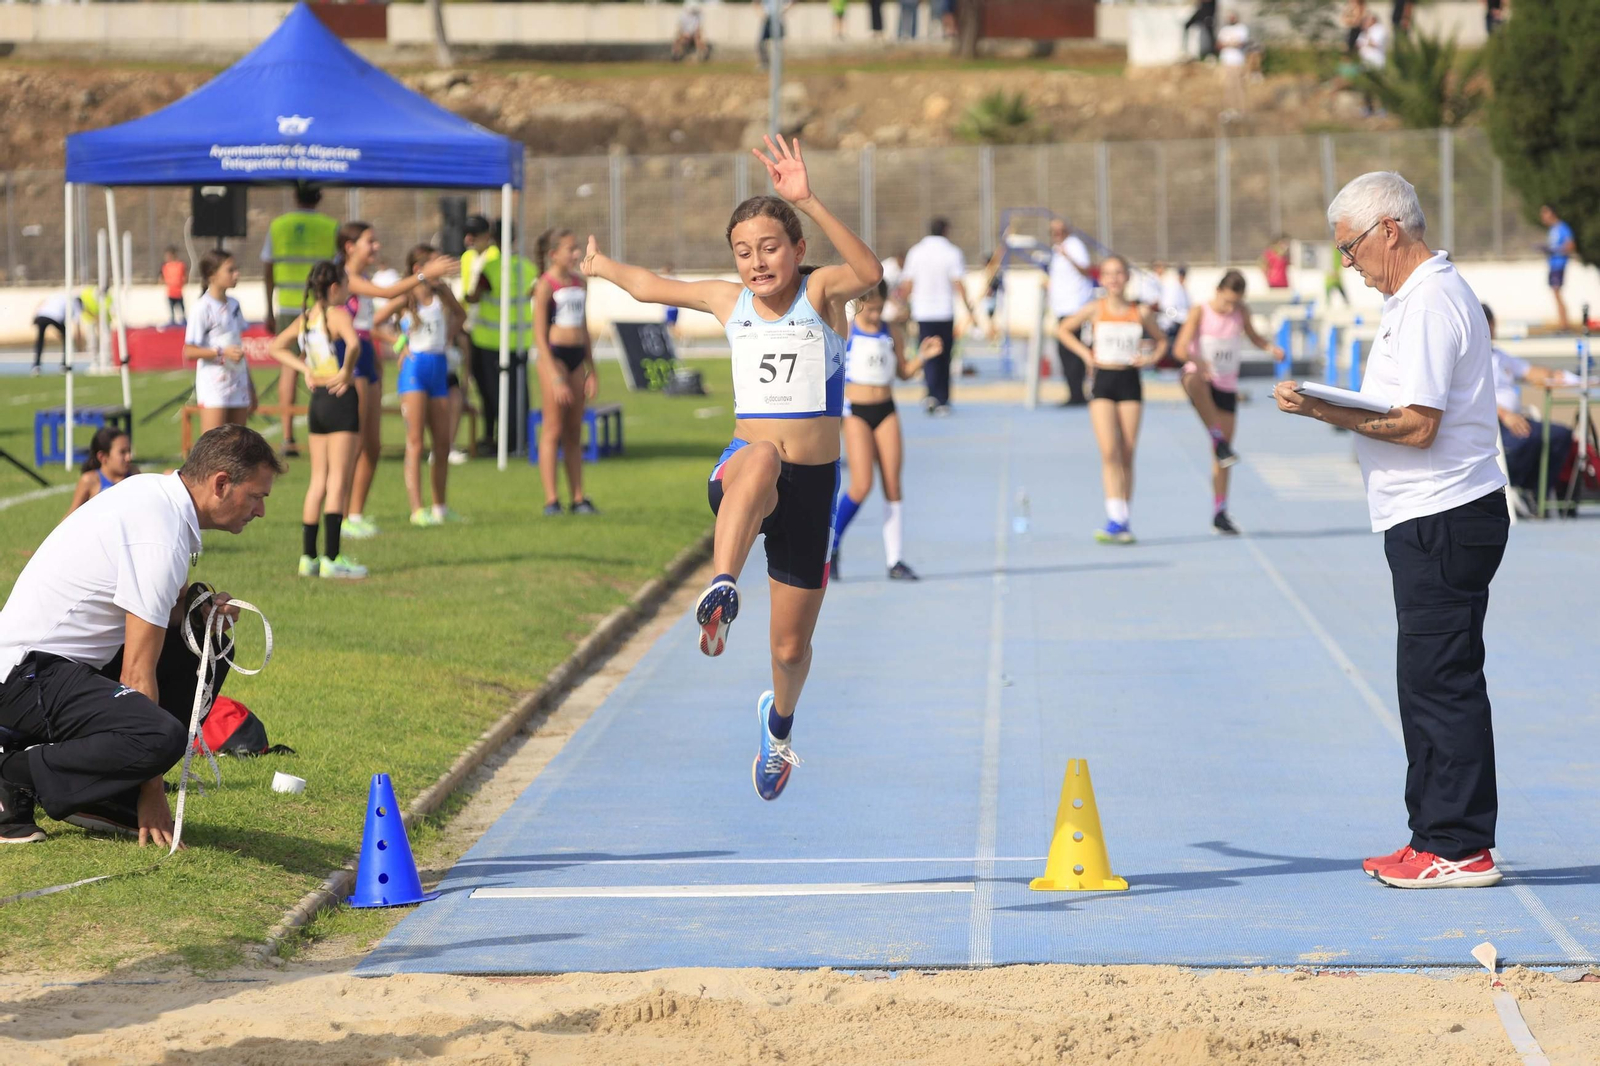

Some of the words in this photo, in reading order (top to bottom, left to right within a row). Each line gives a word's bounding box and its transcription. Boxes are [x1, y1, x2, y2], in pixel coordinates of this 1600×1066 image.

[209, 144, 290, 159] Ayuntamiento
[291, 144, 307, 158] de
[308, 144, 361, 161] Algeciras
[283, 157, 297, 169] de
[298, 157, 349, 172] Deportes
[759, 353, 798, 384] 57
[768, 394, 792, 402] docunova
